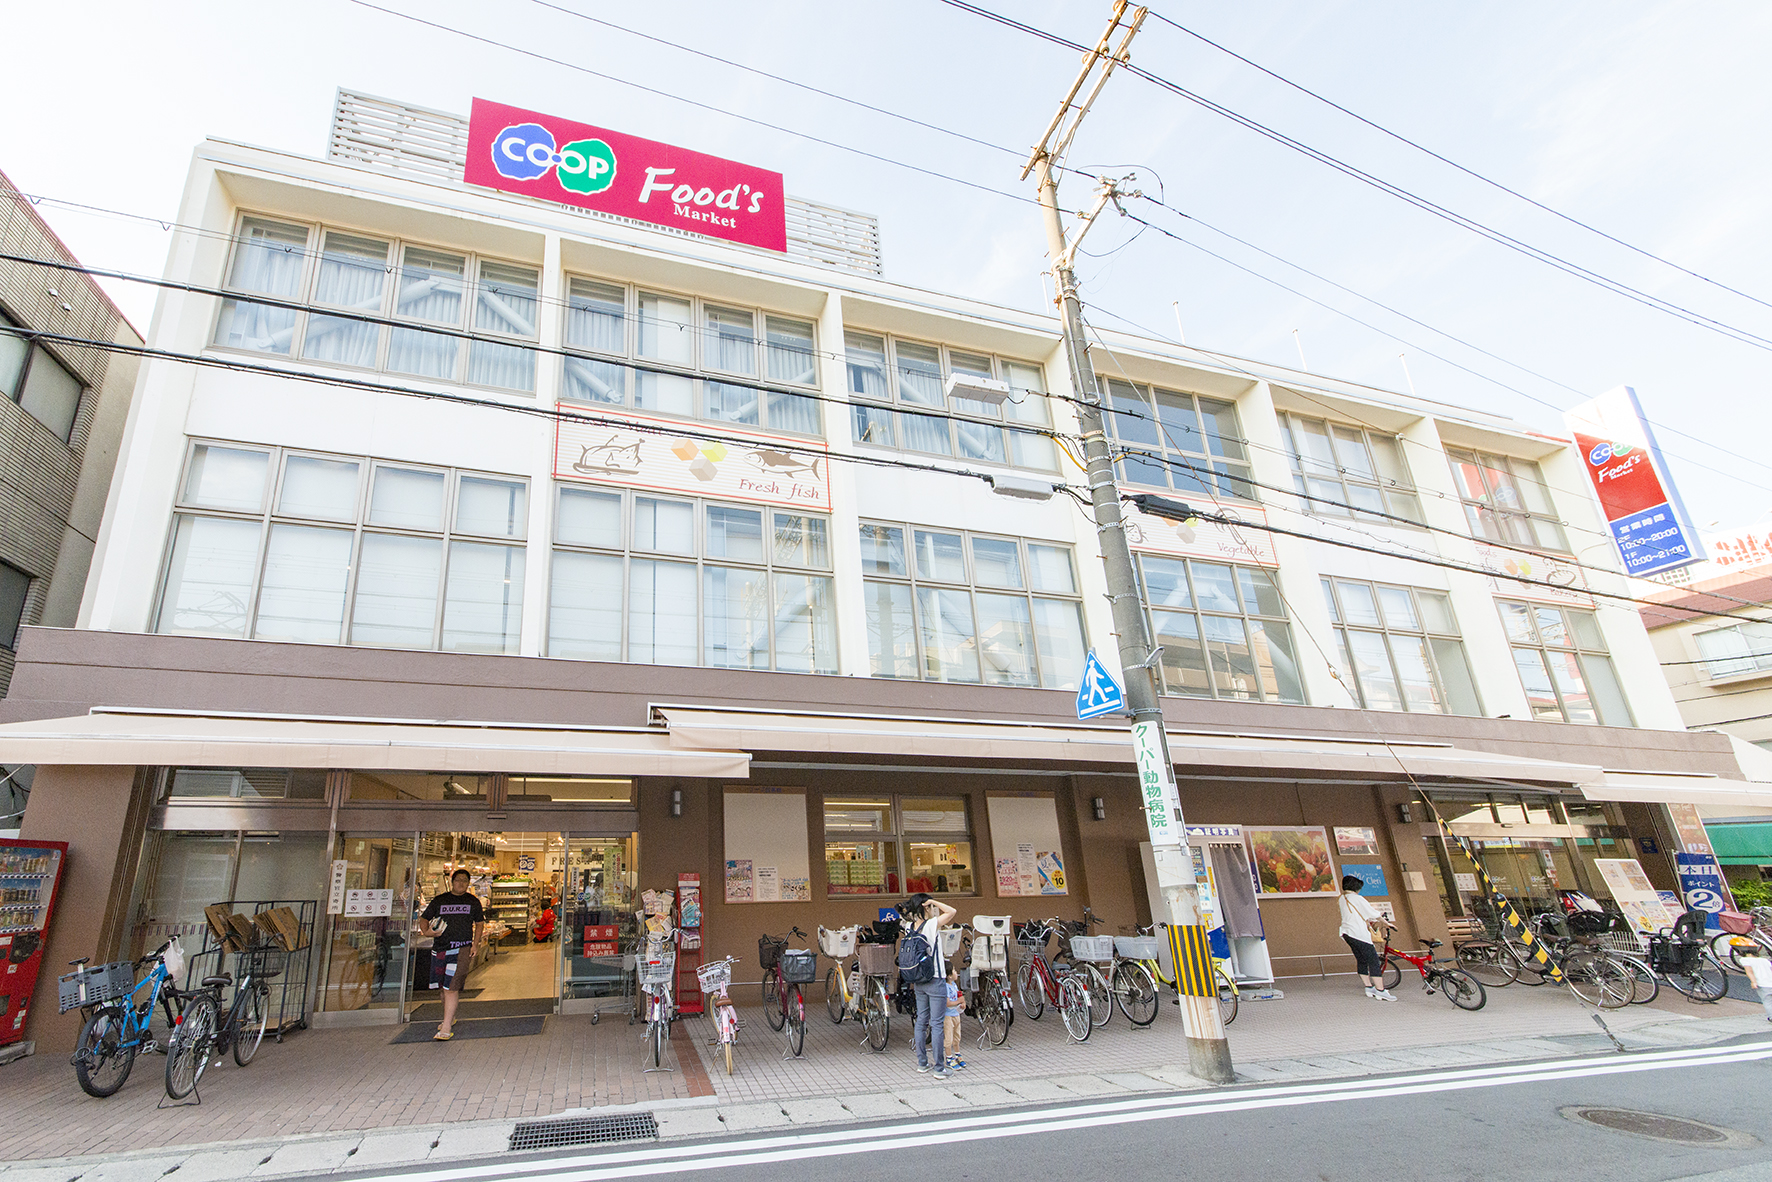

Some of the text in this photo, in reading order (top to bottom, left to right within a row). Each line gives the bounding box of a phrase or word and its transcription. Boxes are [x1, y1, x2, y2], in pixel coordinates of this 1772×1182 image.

[638, 165, 765, 214] Food's
[673, 203, 737, 229] Market
[1597, 454, 1641, 484] Food's
[739, 478, 820, 501] Fresh fish
[1216, 541, 1265, 558] Vegetable
[1624, 551, 1638, 560] 1F
[1136, 724, 1168, 828] クーパー動物病院
[1684, 865, 1713, 875] 本日
[1055, 877, 1065, 885] 10
[1687, 880, 1715, 888] ポイント
[590, 928, 614, 937] 禁煙
